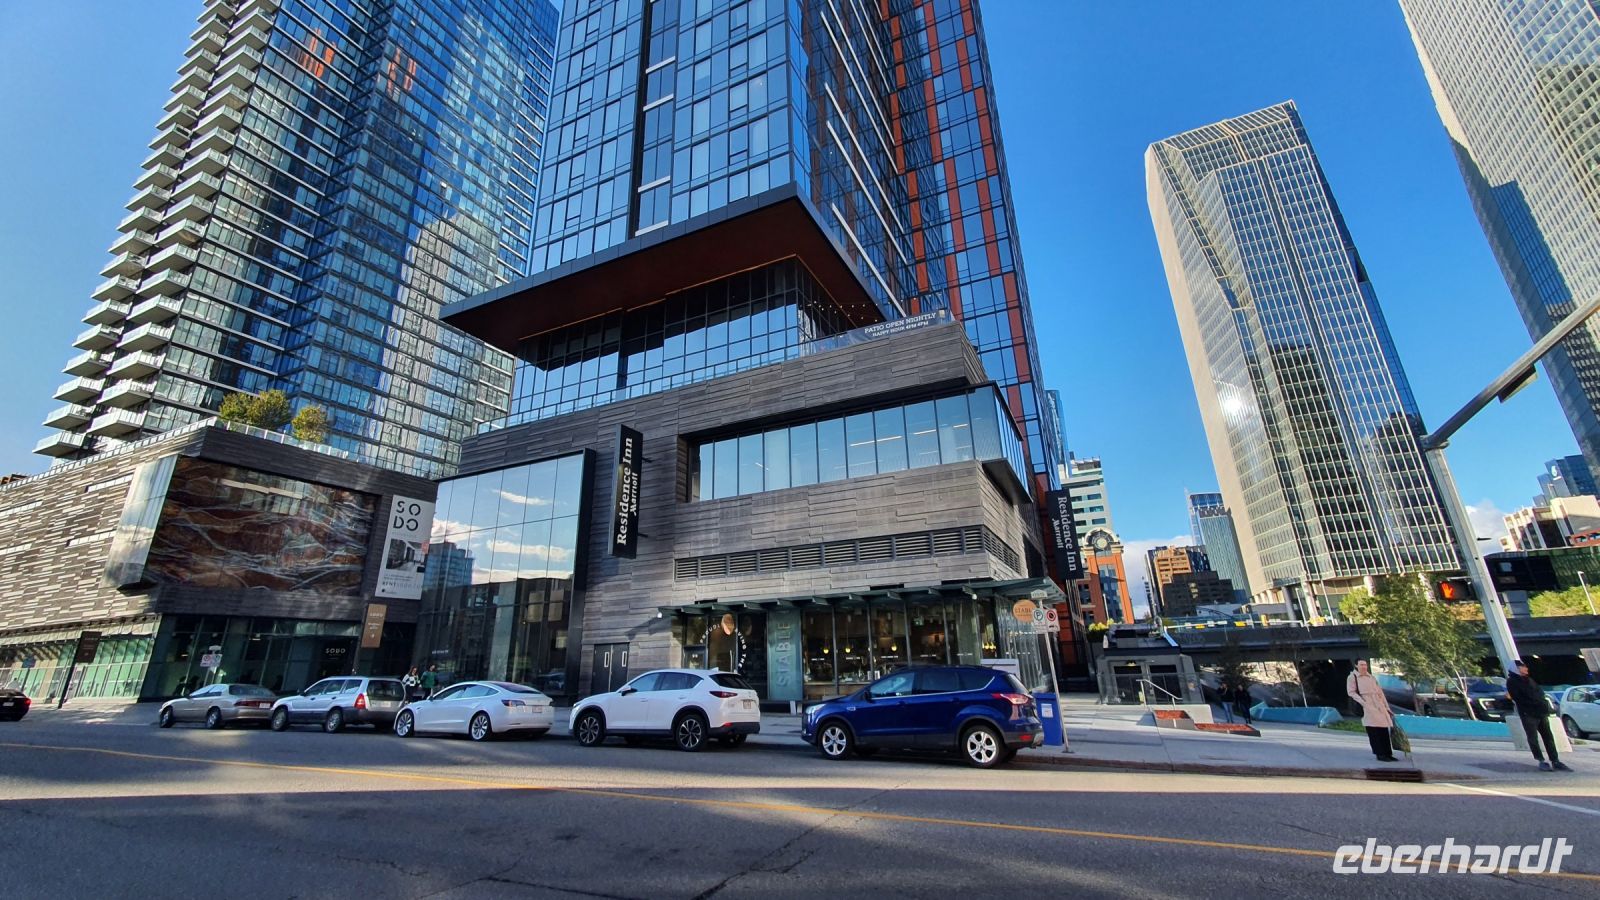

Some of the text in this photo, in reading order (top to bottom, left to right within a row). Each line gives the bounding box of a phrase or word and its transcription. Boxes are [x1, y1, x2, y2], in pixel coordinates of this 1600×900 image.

[864, 312, 936, 333] PATIO OPEN NIGHTLY
[396, 501, 421, 516] SO
[617, 438, 632, 545] Residence Inn
[630, 472, 638, 516] Marriott
[393, 516, 419, 531] DO
[1052, 518, 1064, 548] Marriott
[1058, 496, 1077, 571] Residence Inn
[775, 622, 792, 687] STABLE
